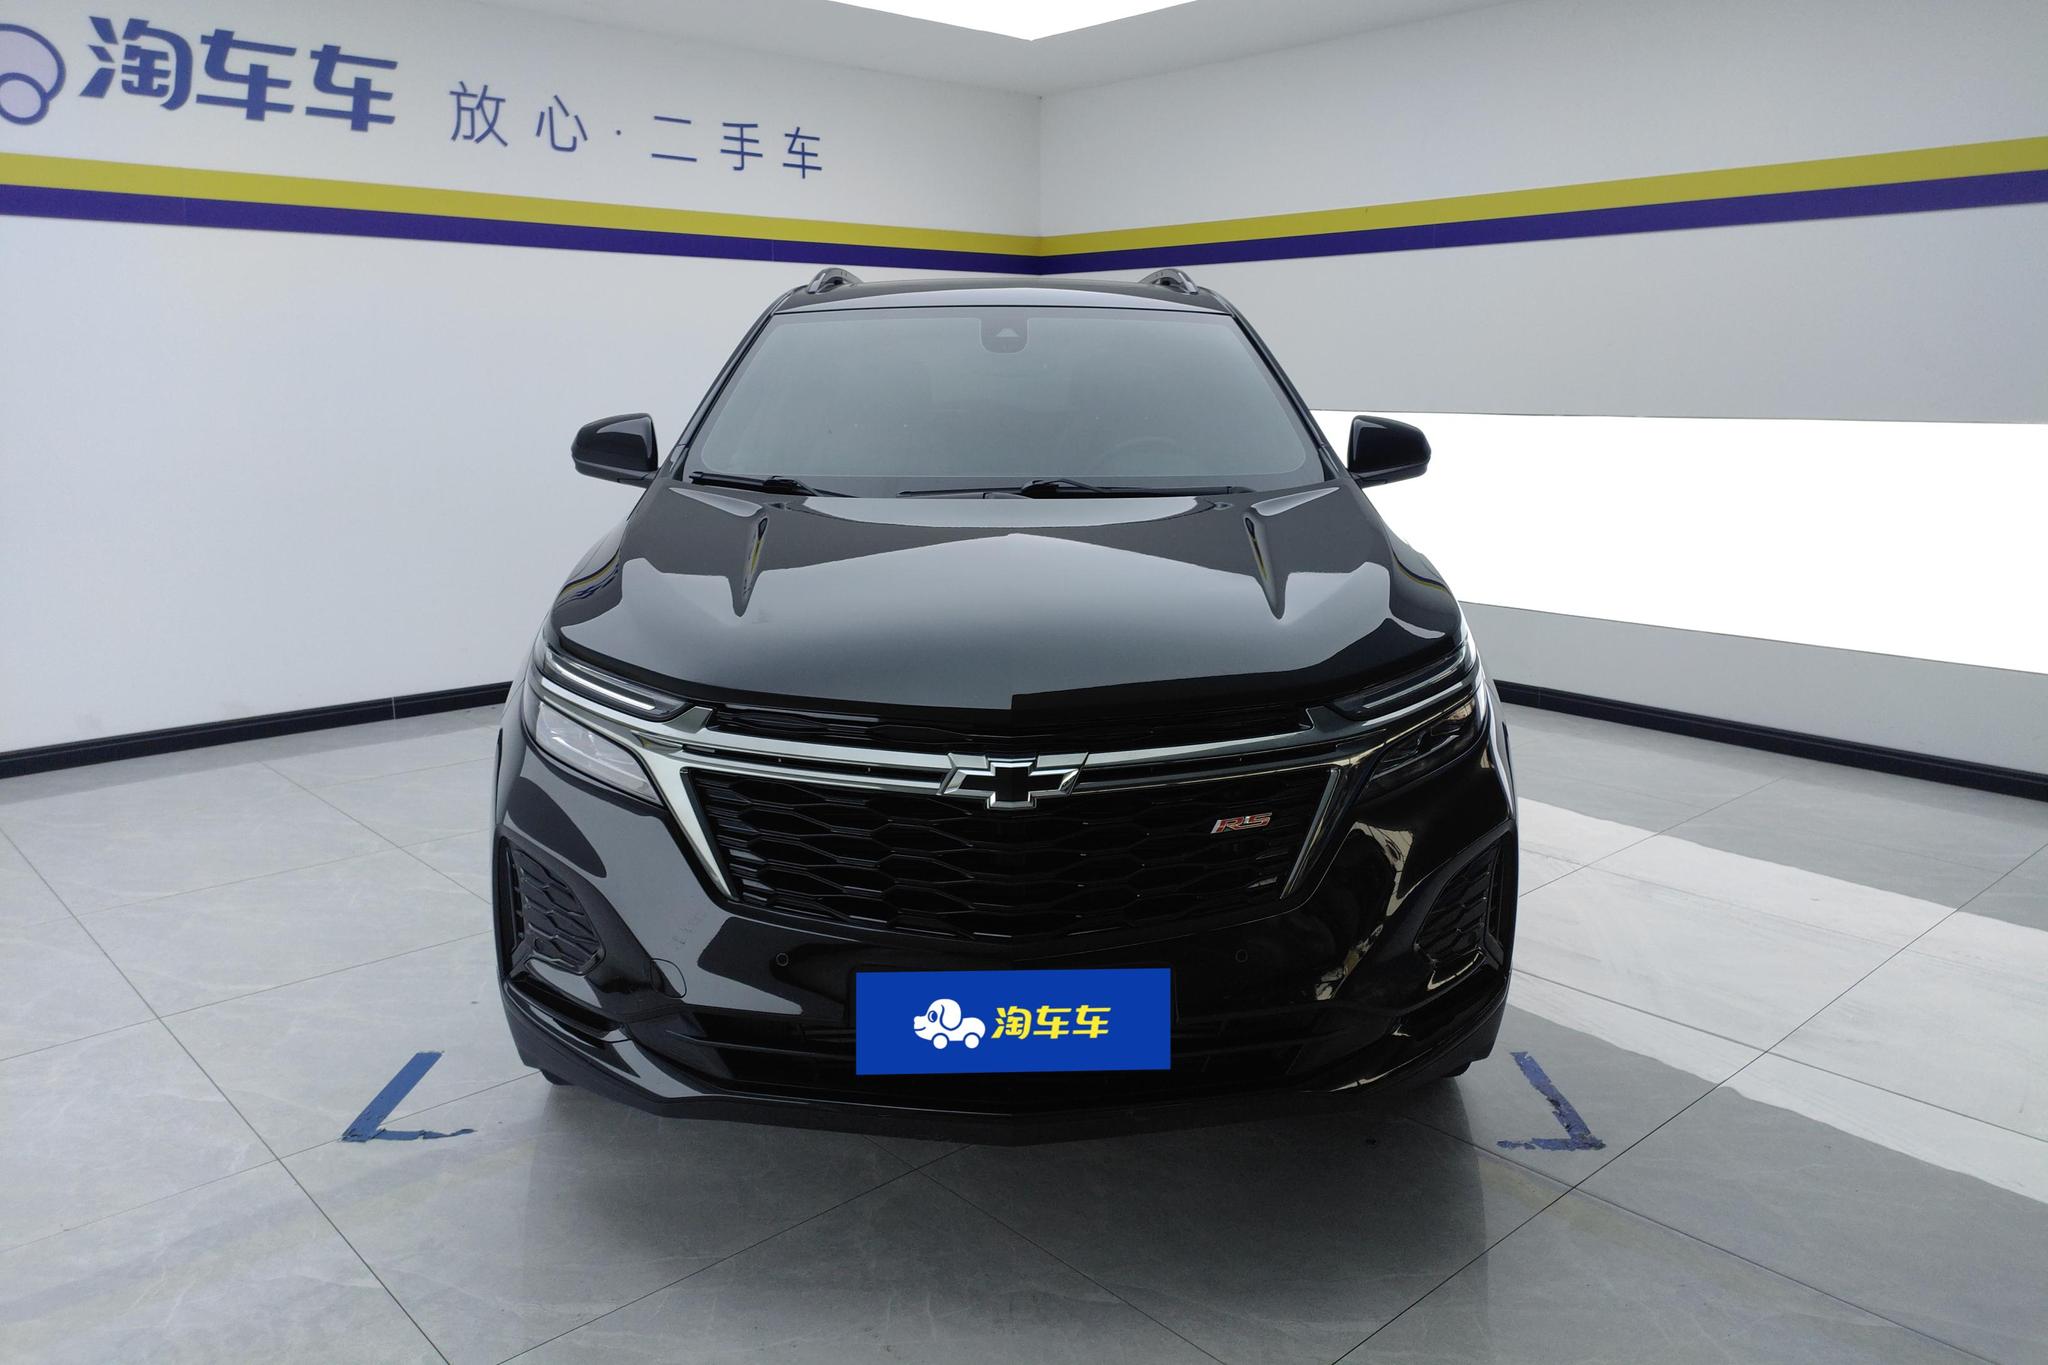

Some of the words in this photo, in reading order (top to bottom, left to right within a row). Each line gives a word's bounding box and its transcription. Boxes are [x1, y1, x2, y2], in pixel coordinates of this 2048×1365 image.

[79, 16, 398, 132] 淘车车
[1210, 812, 1272, 834] RS
